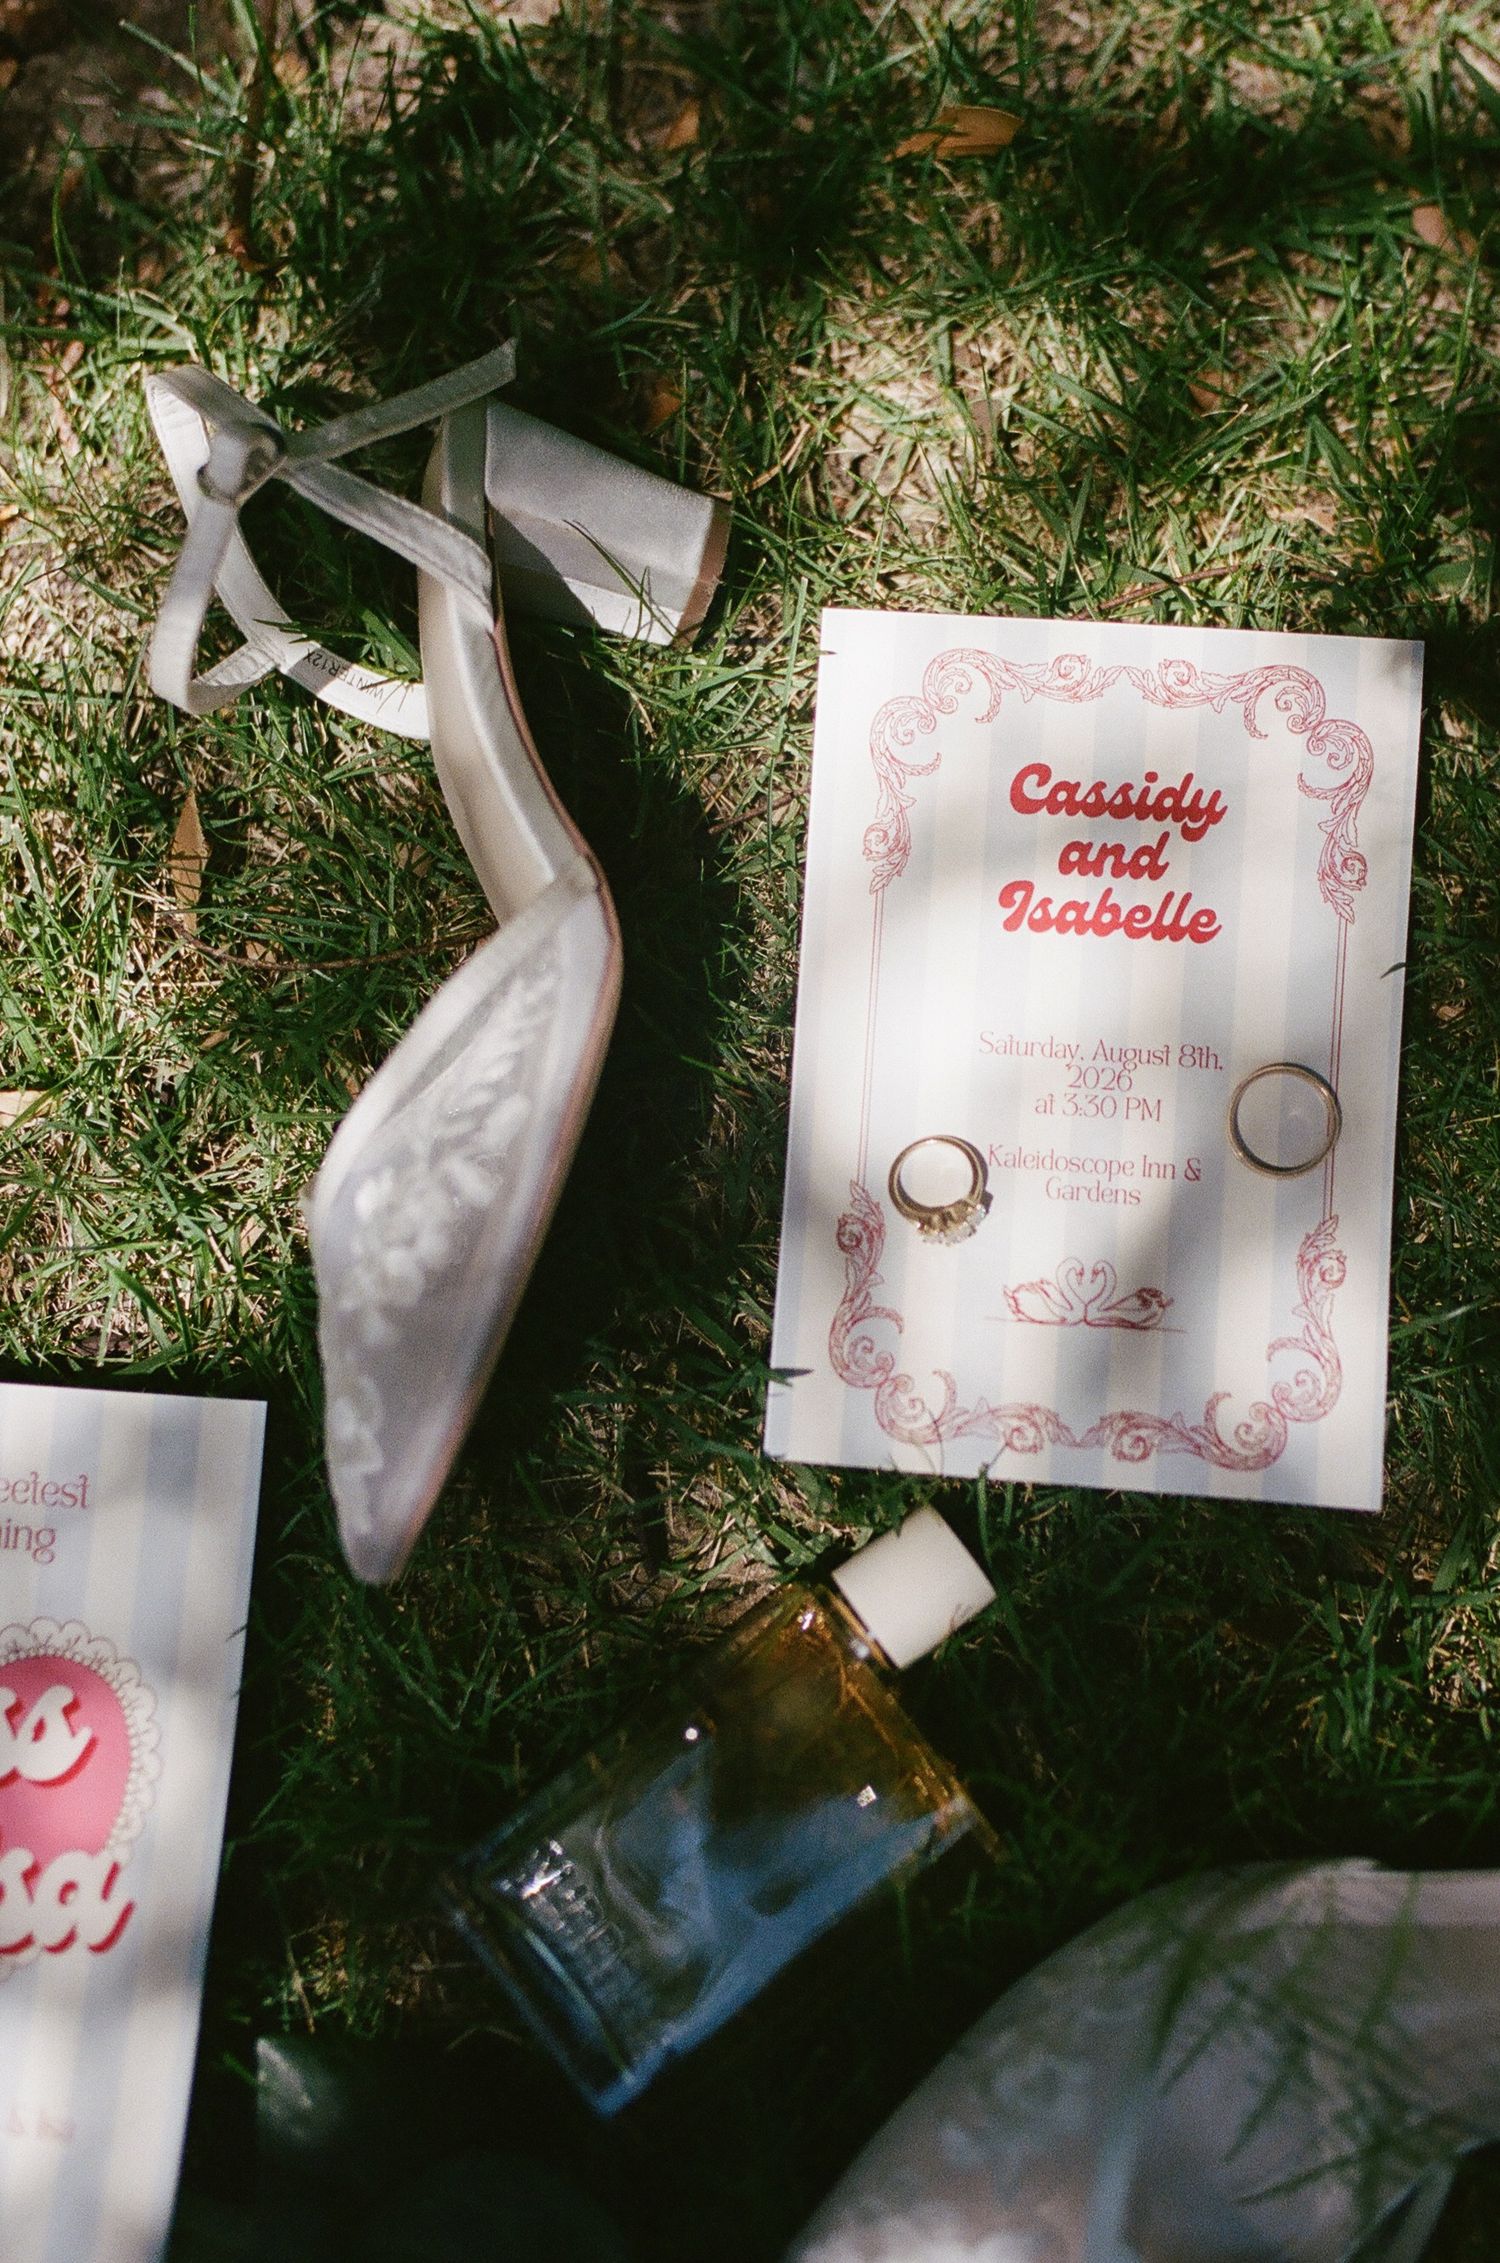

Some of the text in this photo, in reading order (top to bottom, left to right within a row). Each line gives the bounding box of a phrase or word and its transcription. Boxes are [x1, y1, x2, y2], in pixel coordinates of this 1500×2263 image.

[1009, 762, 1228, 842] Cassidy
[1058, 831, 1170, 881] and
[998, 880, 1222, 944] Isabelle
[1092, 1039, 1170, 1072] August
[1066, 1065, 1133, 1092] 2026
[1035, 1092, 1162, 1122] at 3:30 PM
[986, 1143, 1202, 1182] Kaleidoscope Inn &
[1045, 1176, 1142, 1205] Gardens
[0, 1518, 57, 1565] ing
